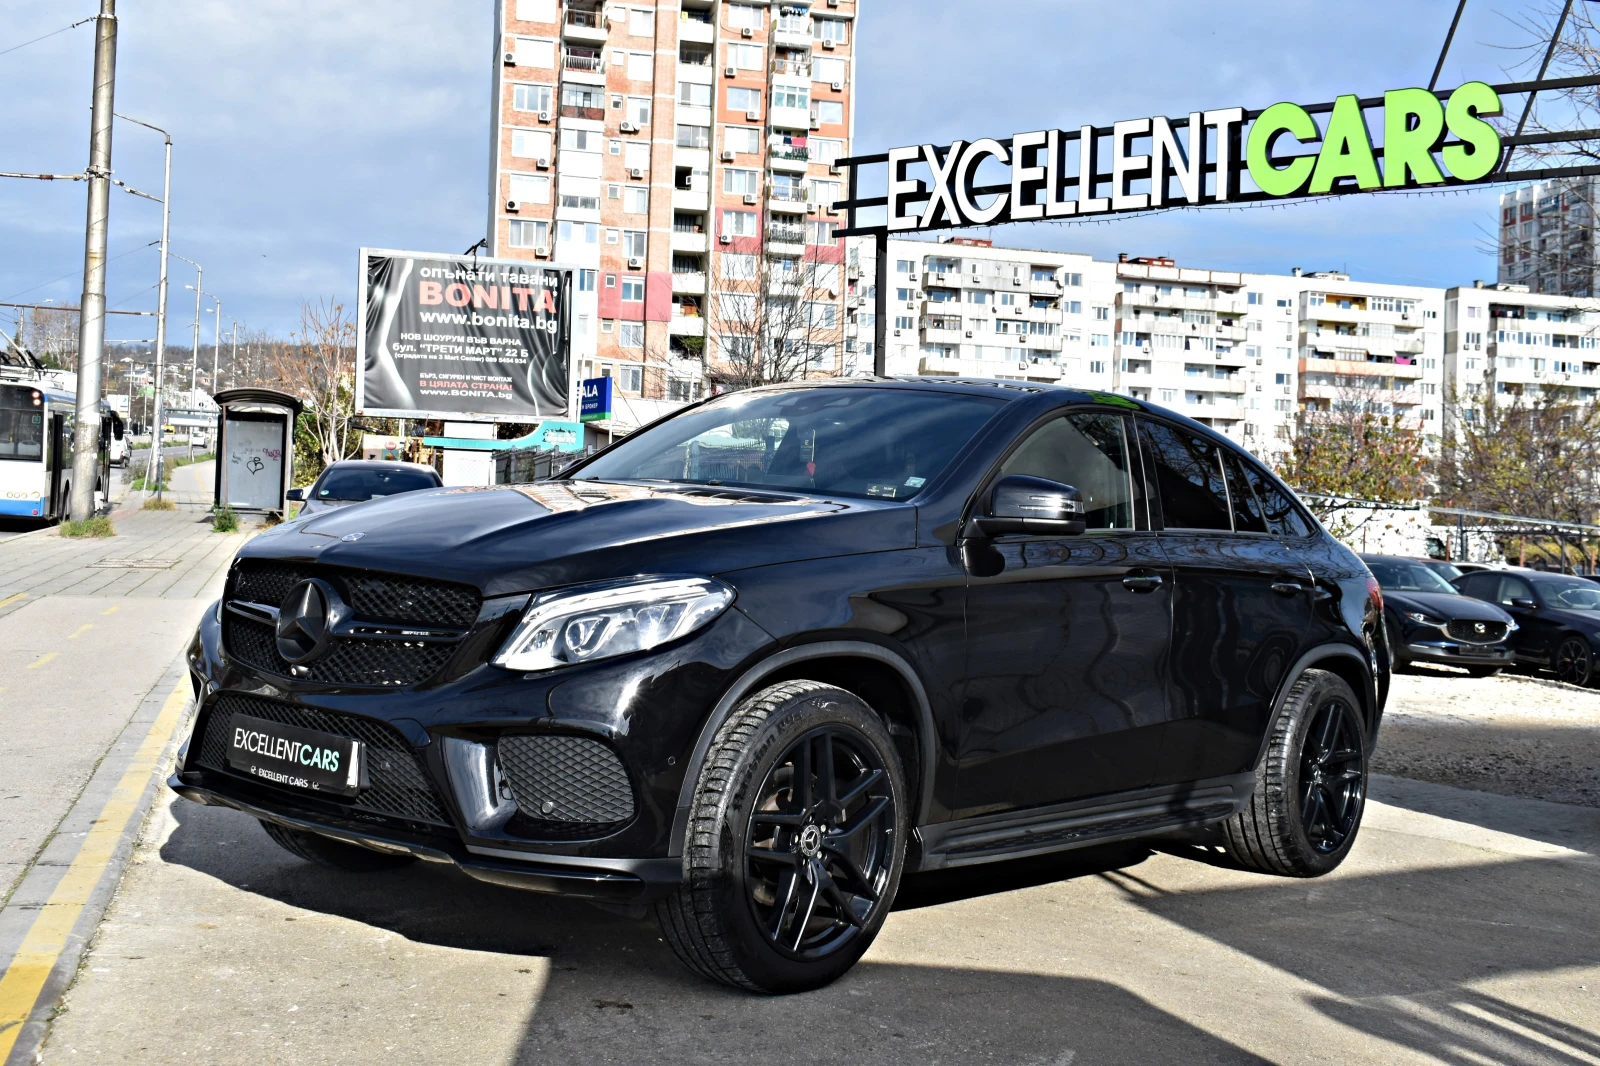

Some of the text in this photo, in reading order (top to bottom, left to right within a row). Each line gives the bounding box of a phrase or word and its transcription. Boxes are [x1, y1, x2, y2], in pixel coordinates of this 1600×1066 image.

[420, 267, 558, 287] опънати тавани
[419, 280, 557, 313] BONITA
[420, 312, 558, 334] www.bonita.bg
[400, 333, 522, 346] НОВ ШОУРУМ ВЪВ ВАРНА
[392, 342, 417, 353] бул.
[505, 348, 518, 357] 22
[520, 349, 529, 358] Б
[419, 389, 513, 400] www.BONITA.bg
[429, 381, 469, 389] ЦЯЛАТА
[471, 382, 513, 391] СТРАНА!
[258, 768, 309, 788] EXCELLENT CARS
